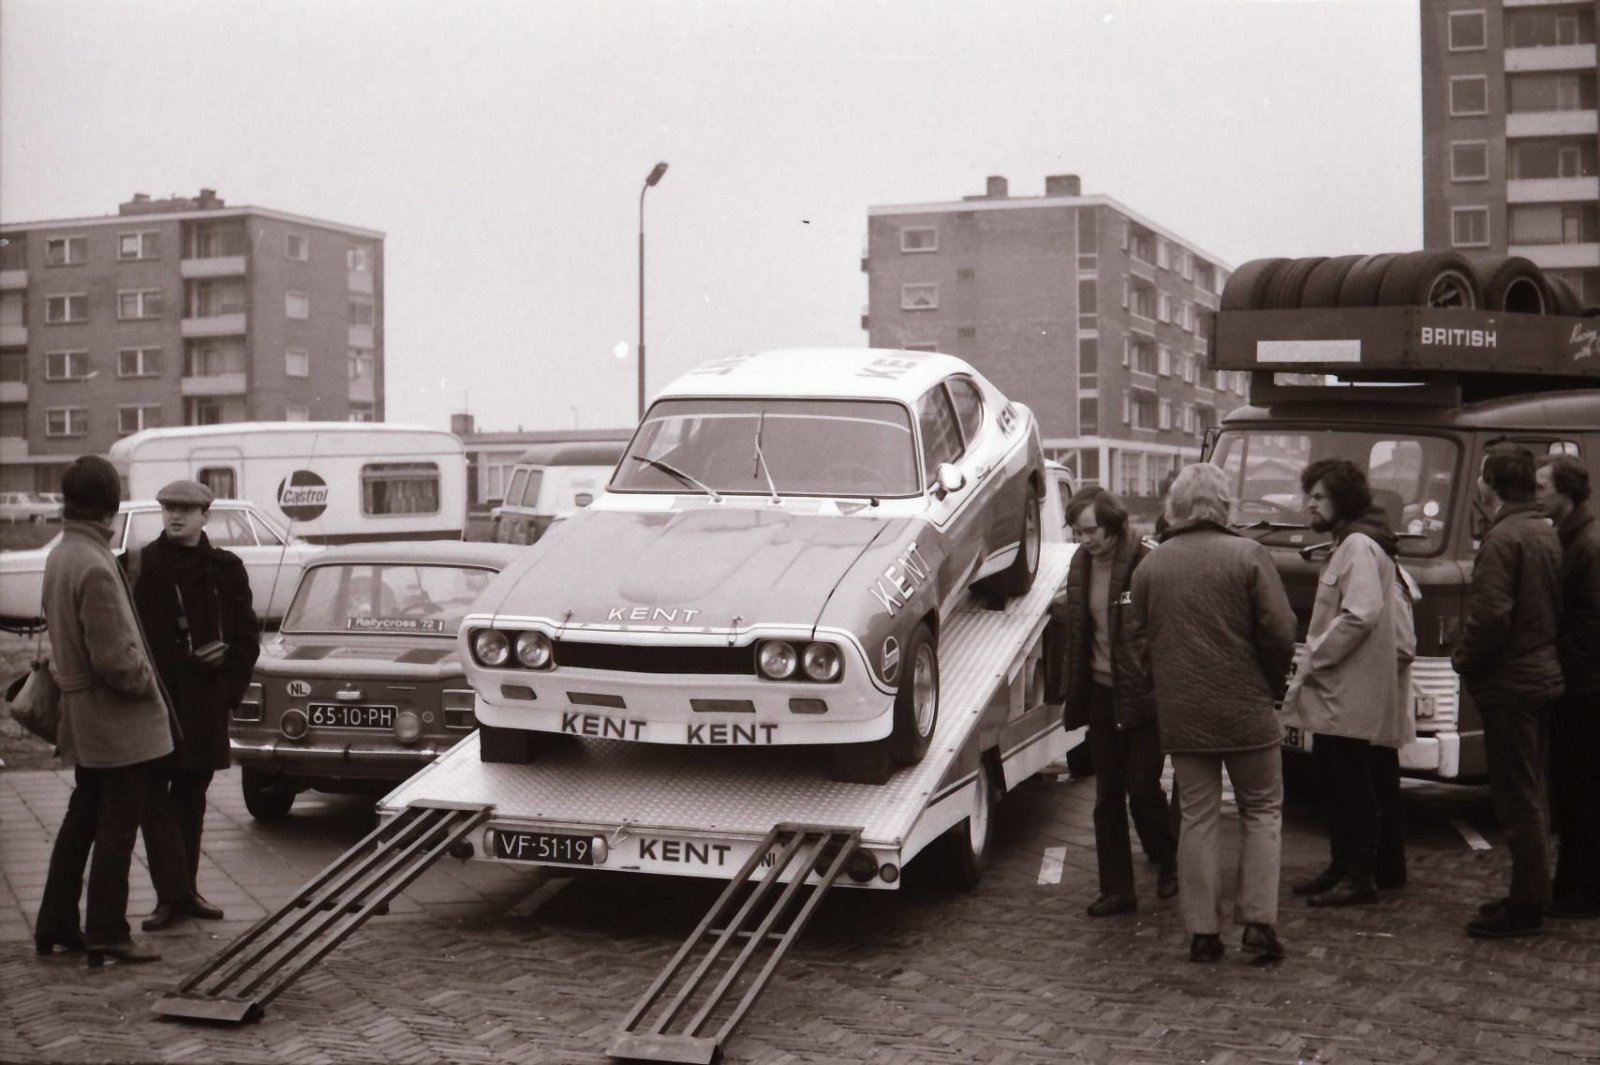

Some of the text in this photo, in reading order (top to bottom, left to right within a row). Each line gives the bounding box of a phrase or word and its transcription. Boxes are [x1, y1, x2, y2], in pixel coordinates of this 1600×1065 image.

[1421, 326, 1497, 348] BRITISH
[282, 488, 329, 504] Castrol
[869, 541, 932, 617] KENT
[355, 618, 417, 629] Rallycross
[607, 606, 702, 624] KENT
[290, 683, 308, 696] NL
[561, 711, 647, 741] KENT
[687, 722, 779, 745] KENT
[639, 837, 732, 866] KENT
